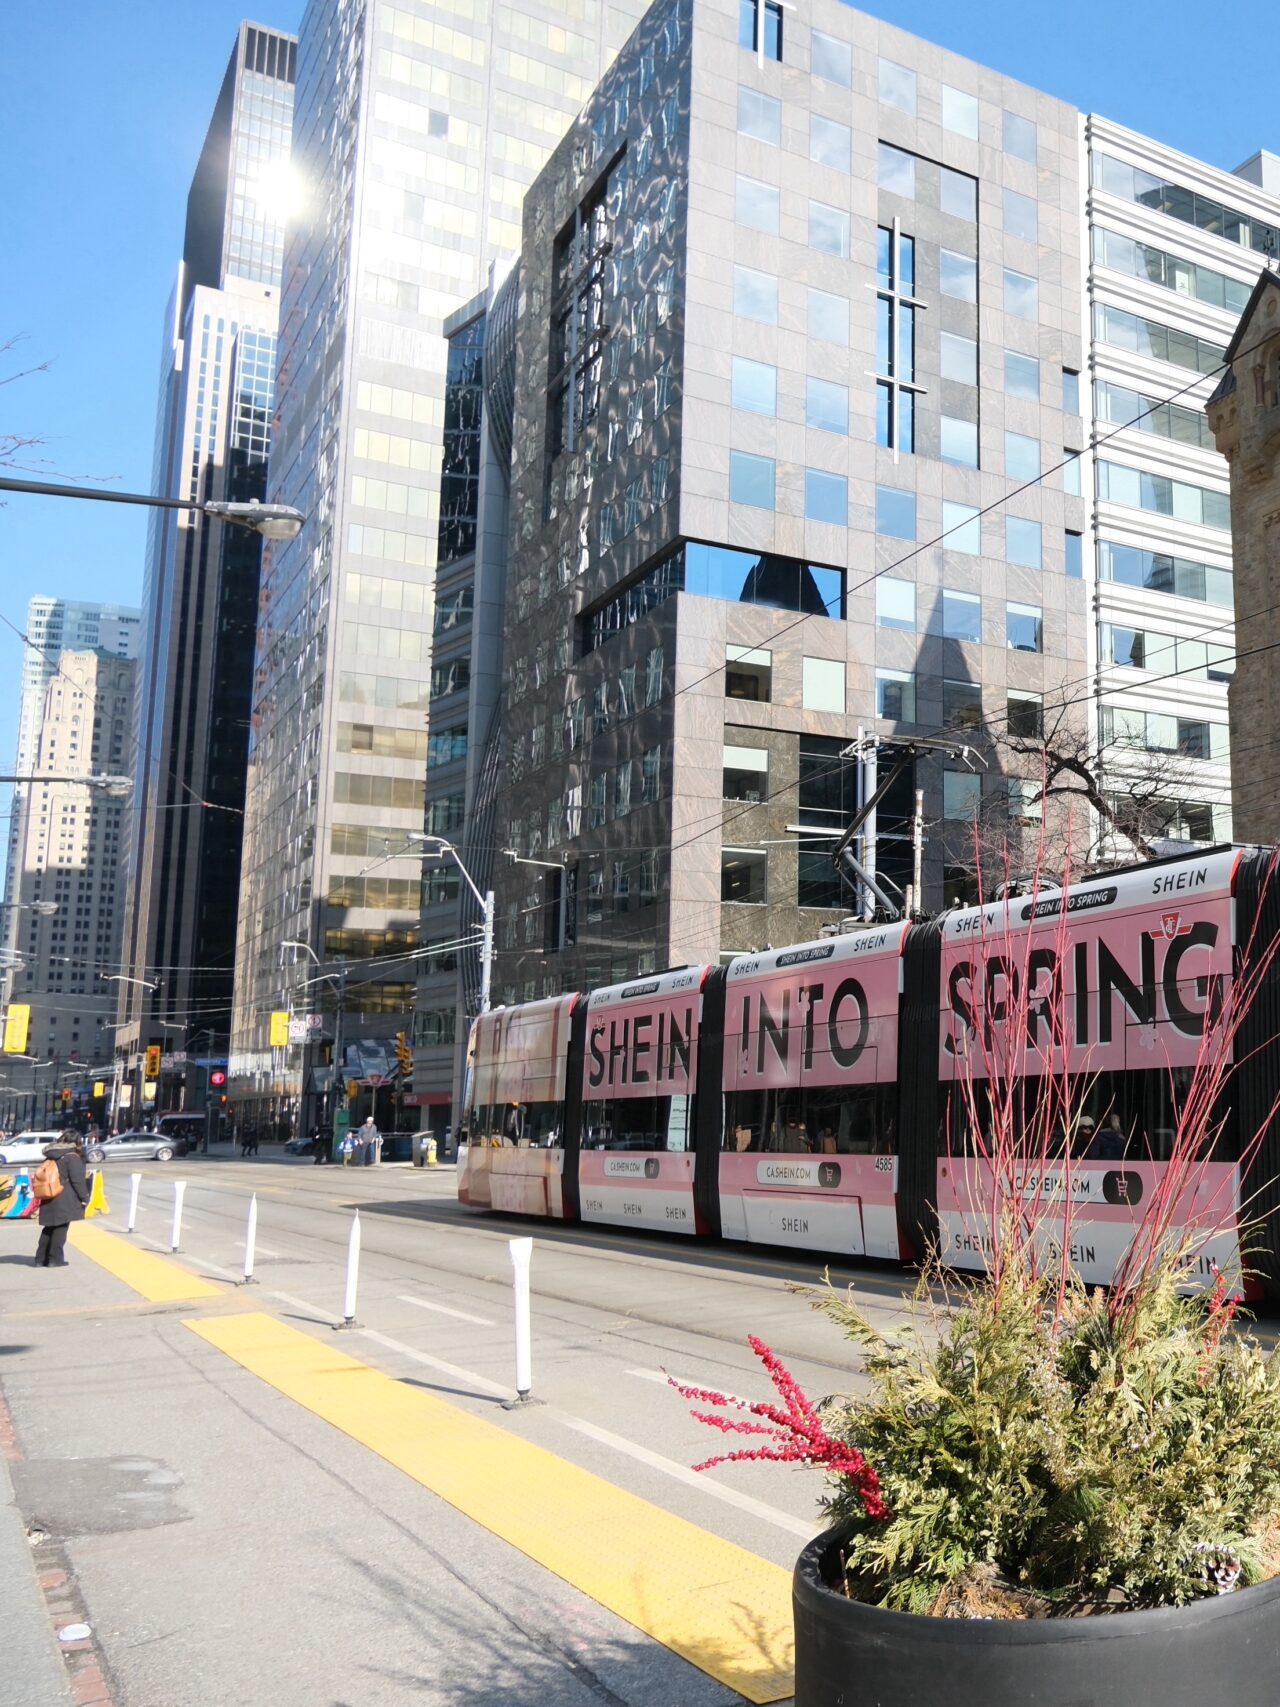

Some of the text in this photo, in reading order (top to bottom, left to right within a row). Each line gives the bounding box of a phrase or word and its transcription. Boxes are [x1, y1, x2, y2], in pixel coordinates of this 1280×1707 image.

[1152, 868, 1208, 894] SHEIN
[1077, 890, 1108, 907] SPRING
[854, 933, 887, 952] SHEIN
[780, 952, 798, 965] SHEIN
[809, 947, 830, 959] SPRING
[734, 960, 761, 976] SHEIN
[671, 976, 694, 988] SHEIN
[589, 921, 1223, 1087] SHEIN INTO SPRING
[593, 993, 611, 1004] SHEIN
[766, 1166, 811, 1179] CA.SHEIN.COM
[875, 1157, 893, 1172] 4585
[586, 1199, 603, 1211] SHEIN
[623, 1203, 642, 1215] SHEIN
[665, 1207, 687, 1219] SHEIN
[781, 1217, 809, 1233] SHEIN
[1048, 1242, 1095, 1263] SEIN
